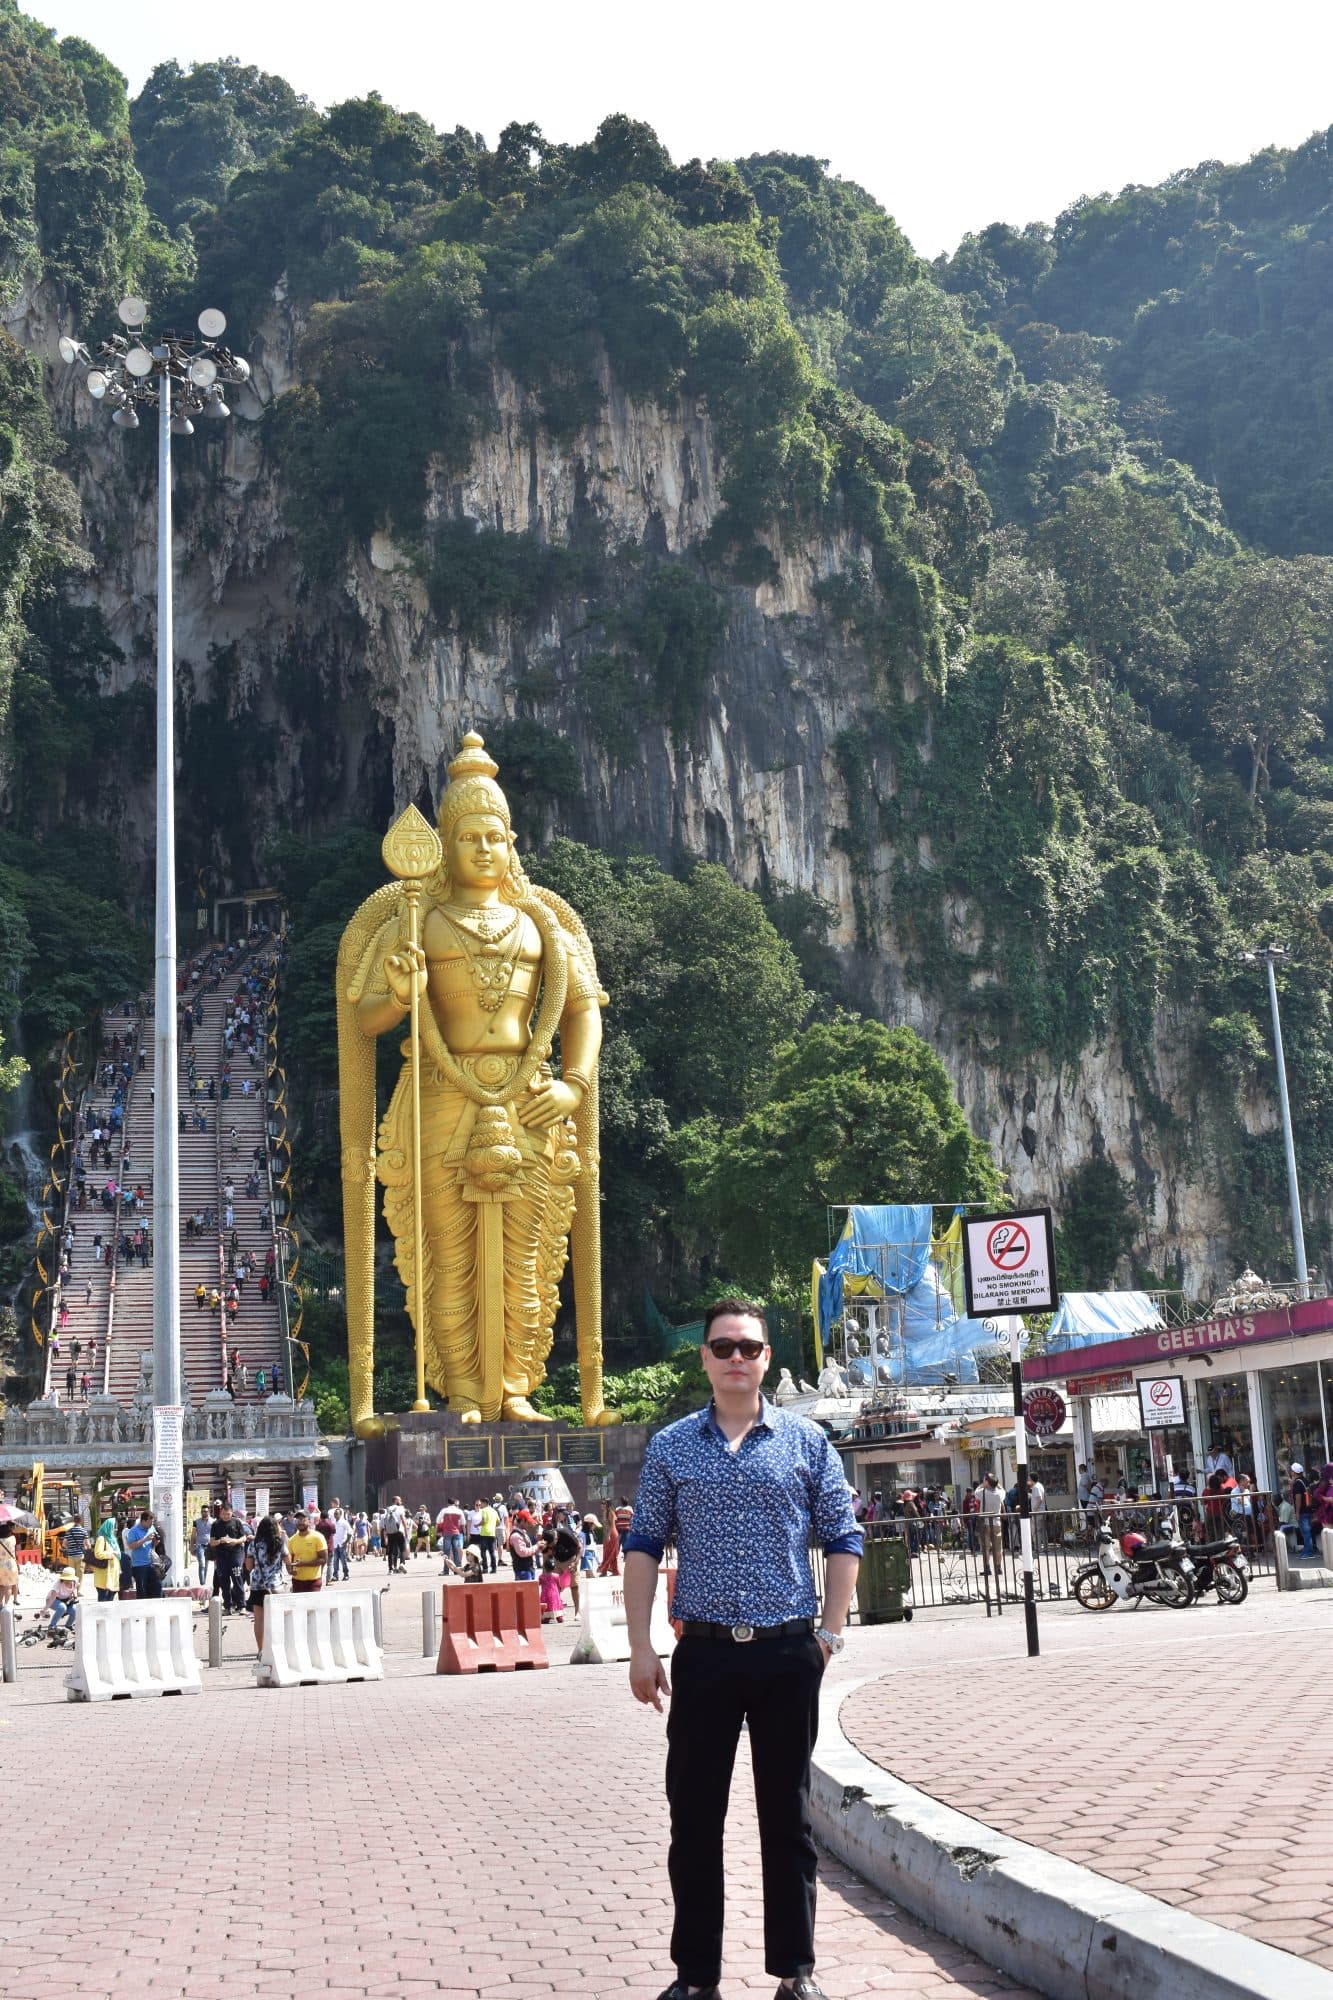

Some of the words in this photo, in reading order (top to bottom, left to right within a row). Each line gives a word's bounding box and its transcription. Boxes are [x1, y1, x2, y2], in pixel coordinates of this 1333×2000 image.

[999, 1281, 1032, 1289] SMOKING
[973, 1290, 1009, 1299] DILARANG
[1011, 1287, 1045, 1296] MEROKOK
[1157, 1318, 1256, 1351] GEETHA'S
